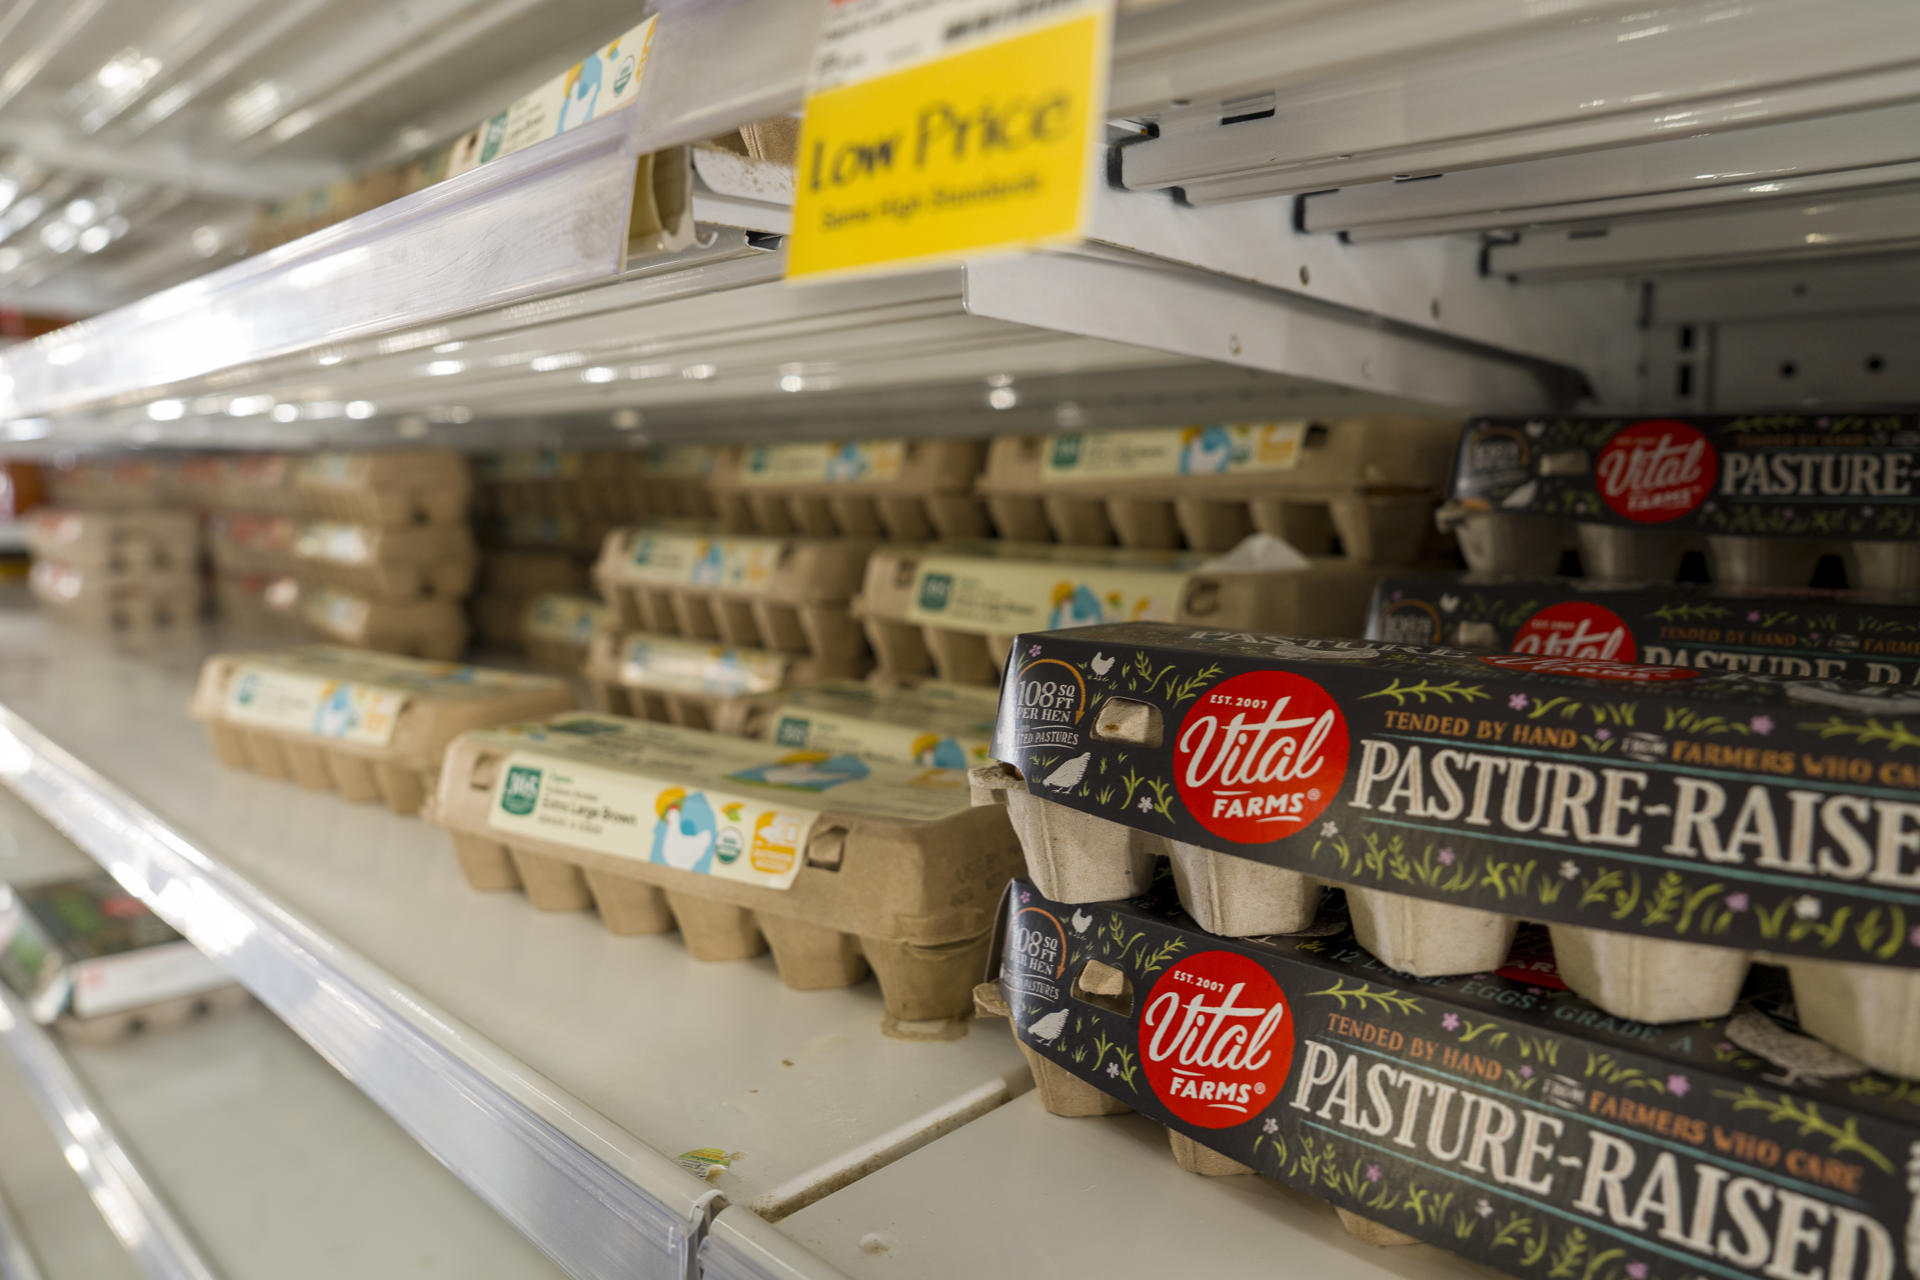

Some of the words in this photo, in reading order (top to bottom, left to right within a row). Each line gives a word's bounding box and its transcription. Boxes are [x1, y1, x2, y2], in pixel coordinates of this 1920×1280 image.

[808, 127, 903, 194] Low
[912, 90, 1073, 170] Price
[1598, 432, 1703, 496] Vital
[1017, 680, 1057, 708] 108
[1058, 684, 1076, 698] SQ
[1054, 696, 1075, 709] FT
[1209, 693, 1234, 706] EST.
[1237, 697, 1269, 710] 2007
[1016, 706, 1039, 720] PER
[1041, 708, 1072, 723] HEN
[1034, 731, 1080, 746] PASTURES
[1178, 695, 1336, 788] Vital
[1384, 709, 1472, 738] TENDED
[1476, 720, 1509, 741] BY
[1512, 723, 1579, 750] HAND
[1671, 740, 1797, 774] FARMERS
[1801, 753, 1874, 783] WHO
[571, 801, 600, 821] Large
[601, 805, 638, 825] Brown
[1040, 948, 1056, 962] FT
[1042, 936, 1058, 951] SQ
[1029, 957, 1055, 976] HEN
[1173, 970, 1195, 984] EST.
[1196, 976, 1225, 993] 2007
[1330, 948, 1361, 963] 12
[1459, 980, 1537, 1011] EGGS
[1553, 1003, 1663, 1043] GRADE
[1145, 982, 1284, 1072] Vital
[1327, 1012, 1404, 1051] TENDED
[1410, 1036, 1439, 1060] BY
[1443, 1046, 1503, 1083] HAND
[1589, 1090, 1707, 1145] FARMERS
[1712, 1126, 1781, 1169] WHO
[1784, 1146, 1863, 1195] CARE
[1290, 1038, 1896, 1280] PASTURE-RAISED
